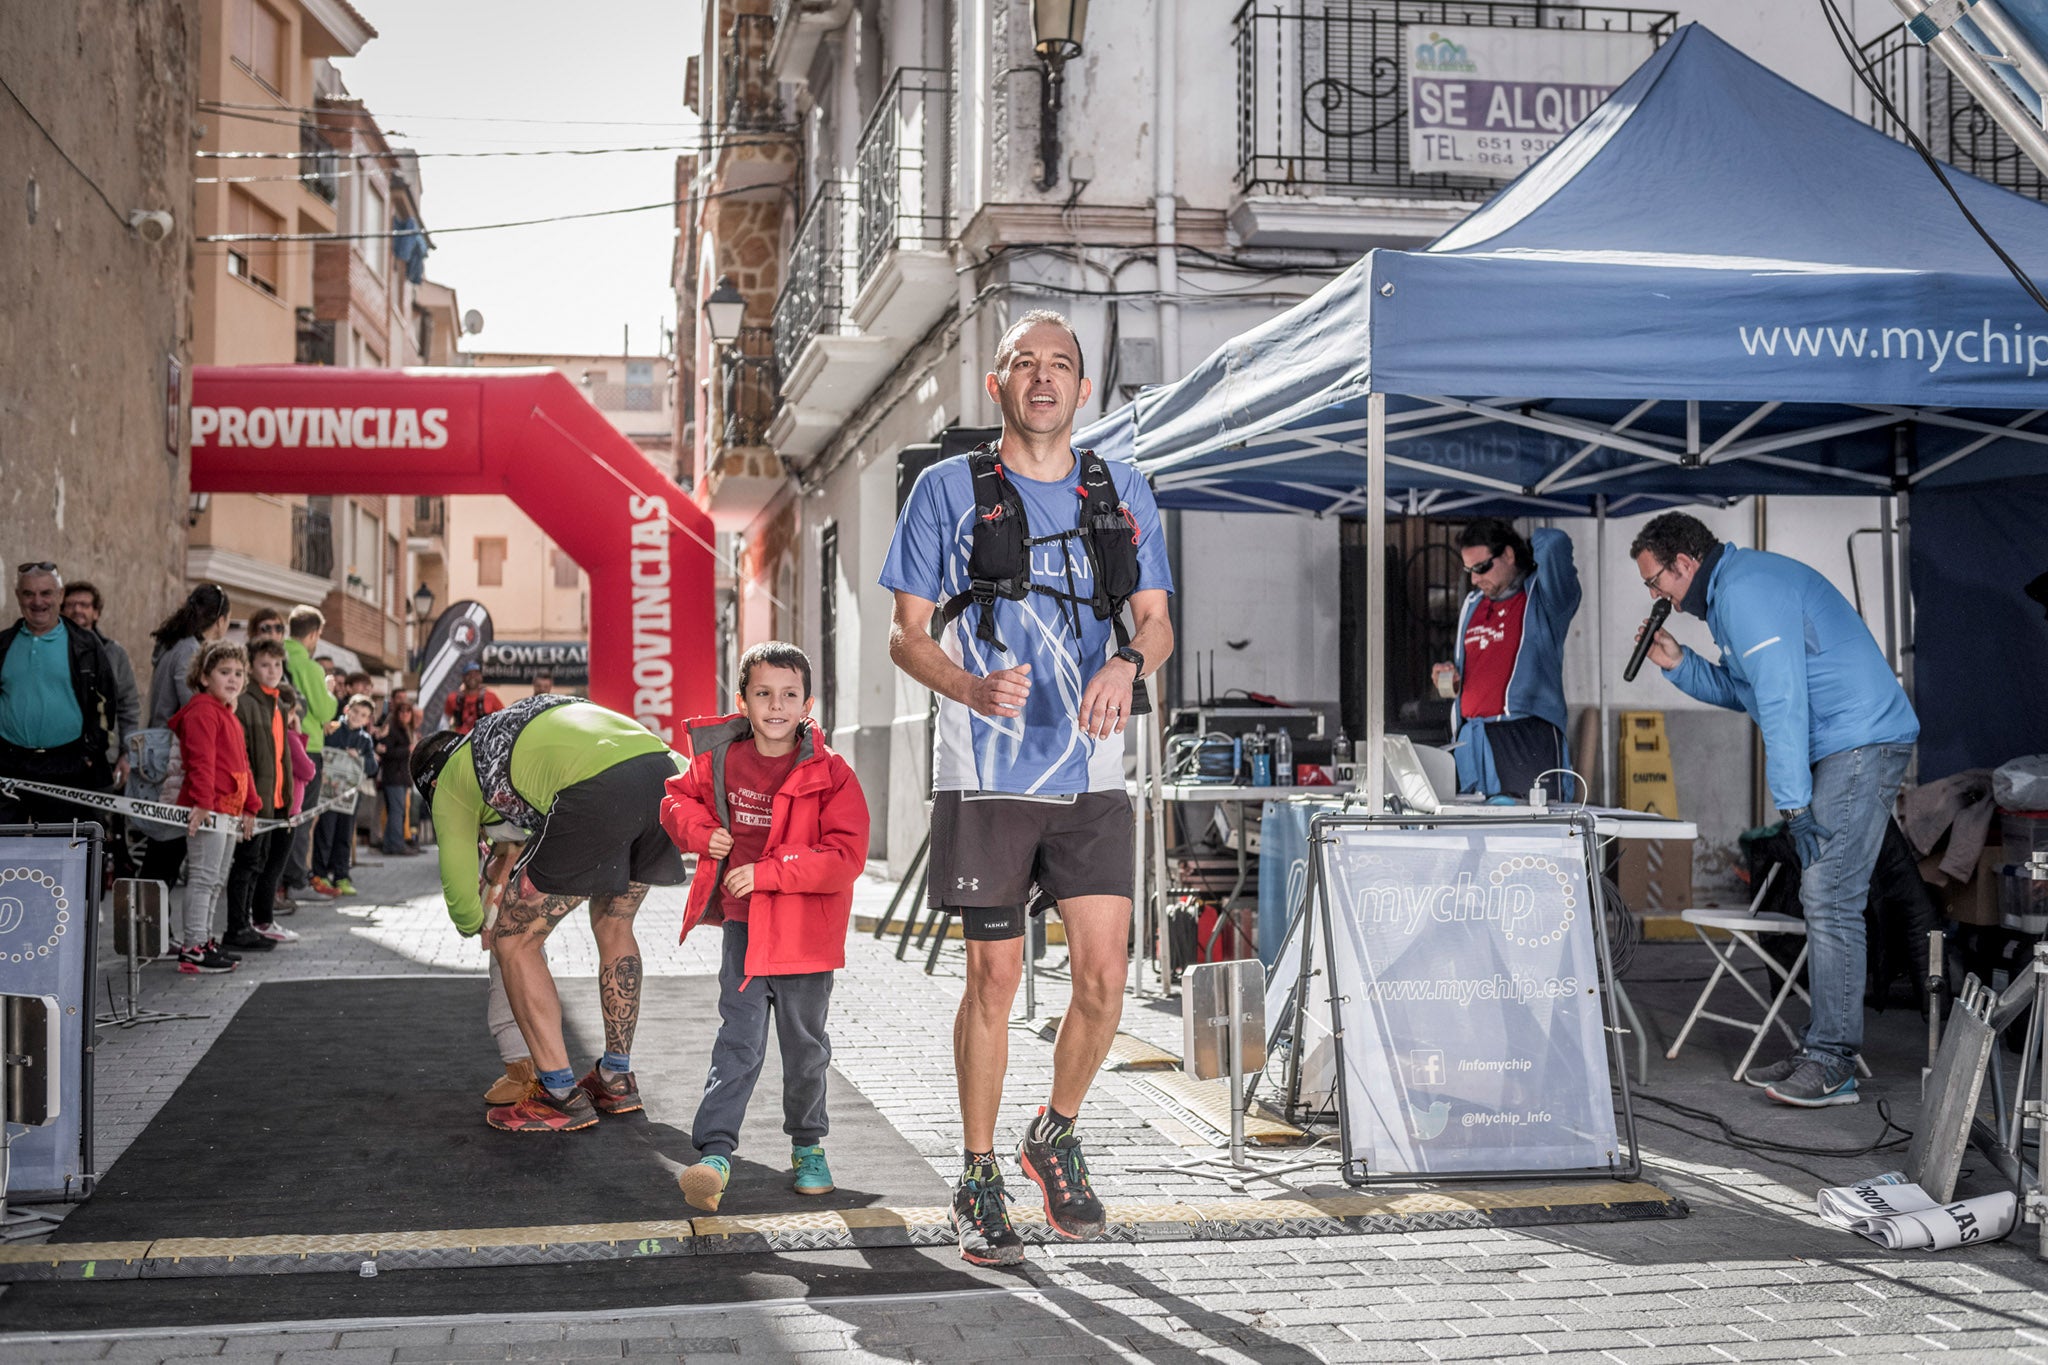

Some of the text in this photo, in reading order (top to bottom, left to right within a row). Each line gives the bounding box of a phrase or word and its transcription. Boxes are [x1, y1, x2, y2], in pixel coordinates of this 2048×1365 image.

[1419, 82, 1468, 126] SE
[1477, 137, 1511, 150] 651
[1478, 152, 1513, 164] 964
[191, 406, 449, 449] PROVINCIAS
[629, 495, 674, 745] PROVINCIAS
[1633, 773, 1667, 784] CAUTION
[130, 802, 191, 825] ROVINCIAS
[1356, 872, 1536, 935] mychip
[1360, 974, 1578, 1007] www.mychip.es
[1945, 1204, 1980, 1242] LAS
